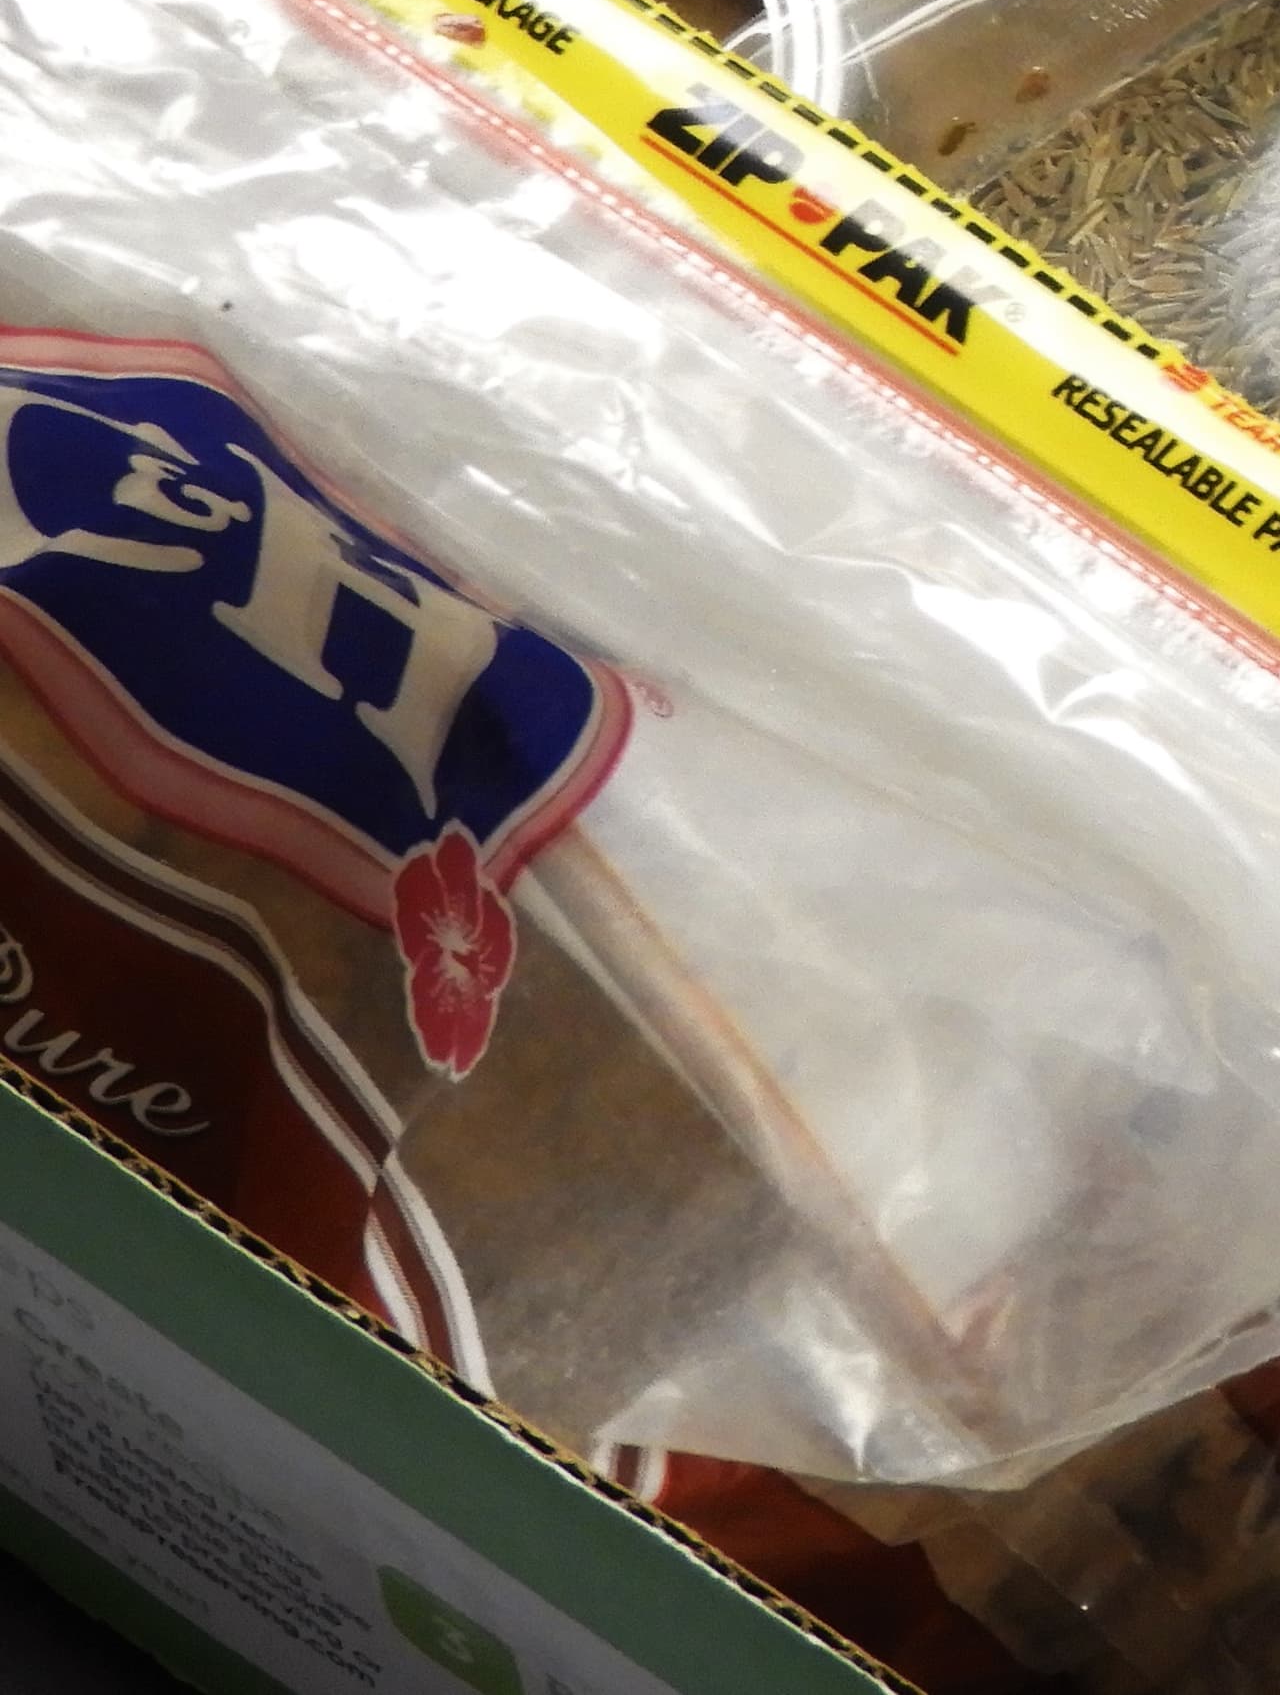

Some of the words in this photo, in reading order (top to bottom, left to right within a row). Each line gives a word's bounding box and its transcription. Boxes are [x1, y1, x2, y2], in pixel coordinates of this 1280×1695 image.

[646, 69, 805, 209] ZIP
[816, 187, 1008, 351] PAK
[1048, 366, 1264, 532] RESEALABLE
